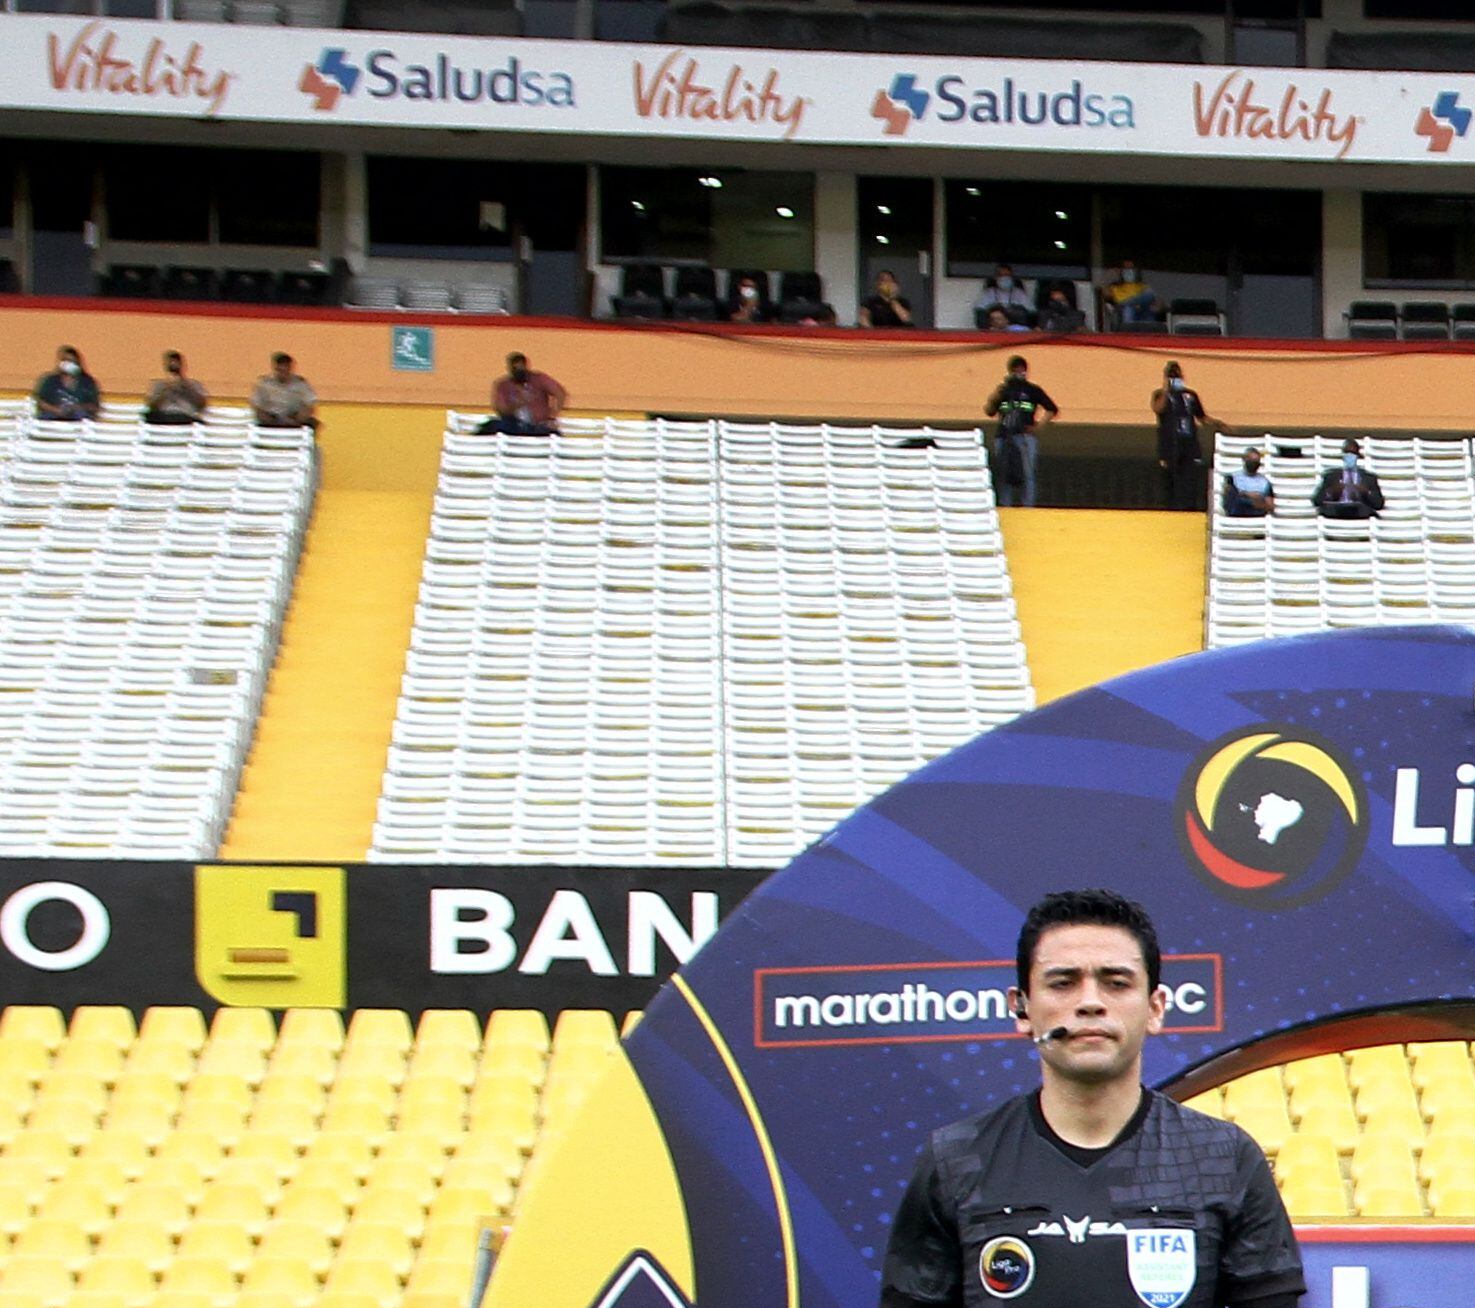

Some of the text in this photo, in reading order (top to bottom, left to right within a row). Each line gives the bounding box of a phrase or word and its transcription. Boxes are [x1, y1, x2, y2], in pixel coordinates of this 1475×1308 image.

[48, 20, 232, 115] Vitality
[366, 50, 577, 106] Saludsa
[632, 50, 805, 138] Vitality
[936, 75, 1135, 128] Saludsa
[1193, 70, 1357, 158] Vitality
[0, 882, 110, 970] O
[1134, 1235, 1188, 1254] FIFA
